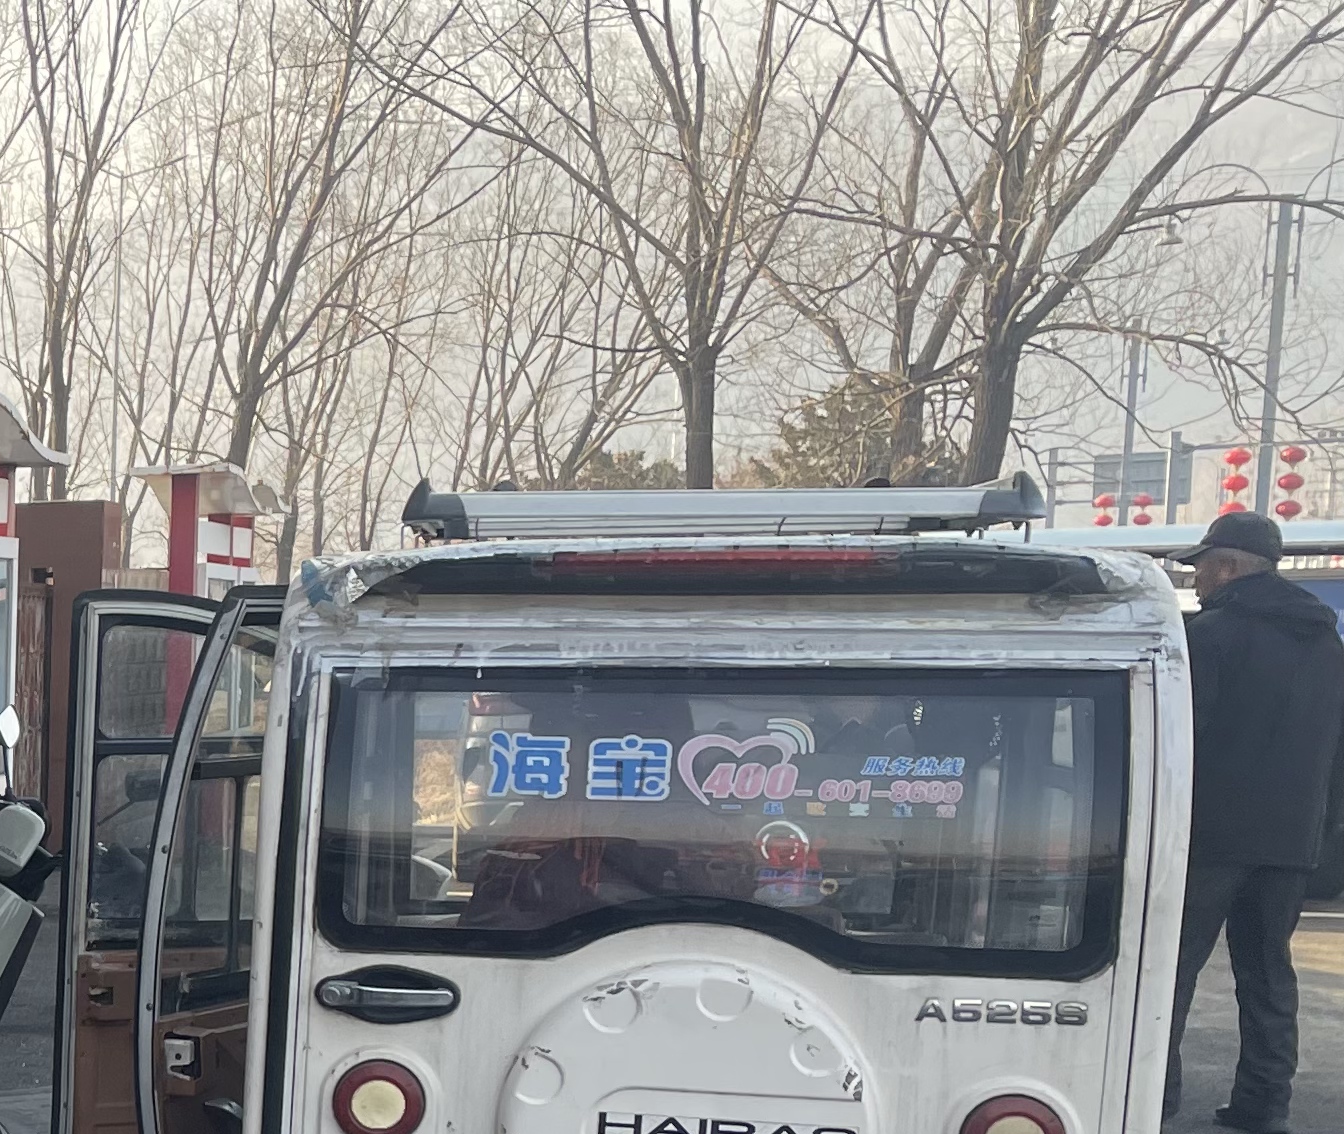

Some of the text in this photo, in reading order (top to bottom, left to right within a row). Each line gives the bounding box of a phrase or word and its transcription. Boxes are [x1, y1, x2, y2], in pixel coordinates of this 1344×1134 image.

[486, 729, 673, 801] 海宝
[860, 755, 965, 778] 服务热线
[915, 998, 1088, 1026] A525S
